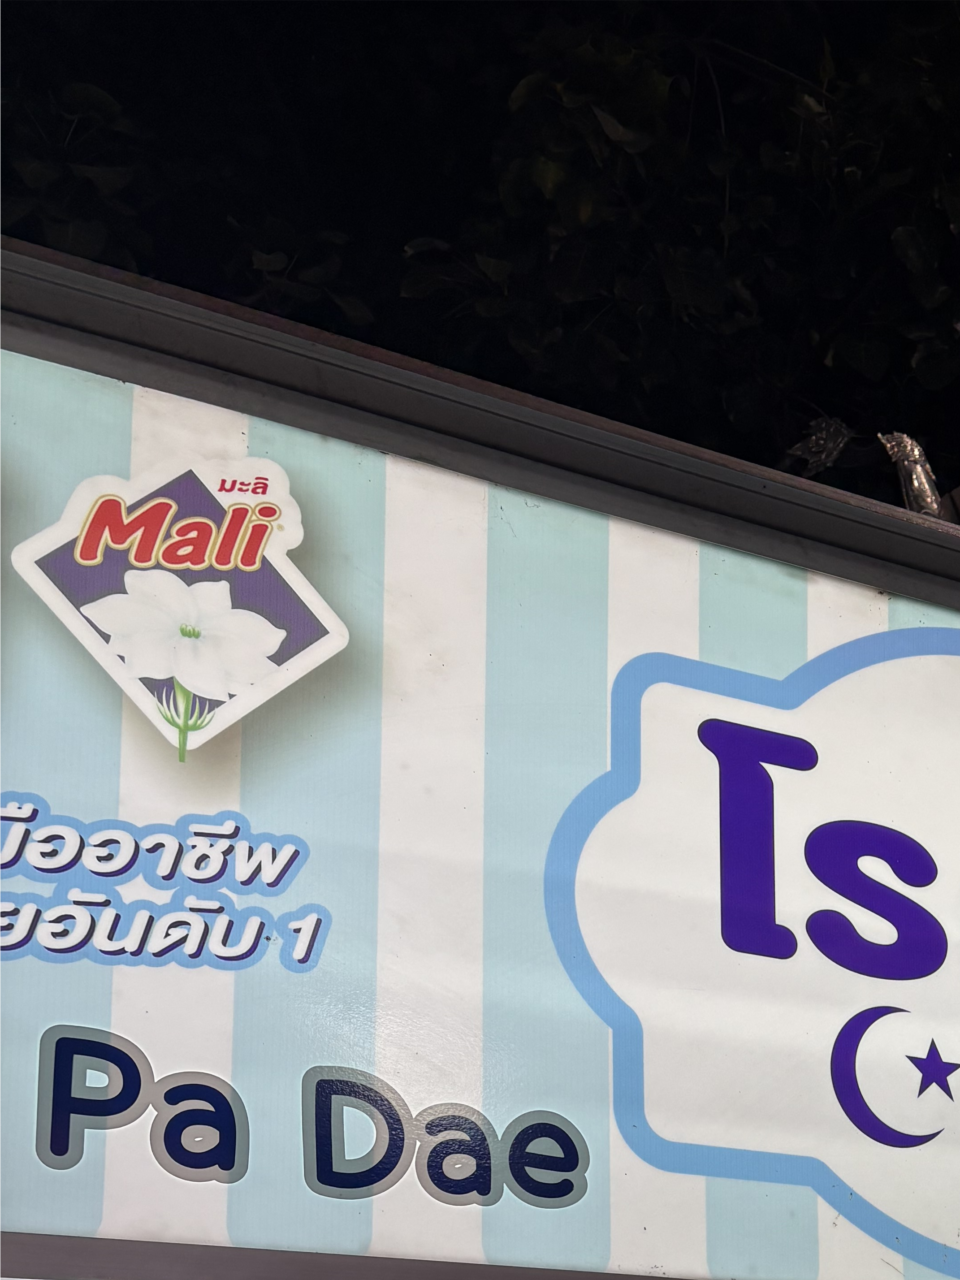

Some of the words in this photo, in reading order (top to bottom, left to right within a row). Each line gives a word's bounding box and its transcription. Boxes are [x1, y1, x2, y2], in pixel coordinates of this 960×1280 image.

[218, 477, 270, 496] มะลิ
[77, 496, 279, 570] Mali
[288, 913, 322, 964] 1
[44, 1031, 243, 1177] Pa
[309, 1073, 586, 1203] Dae
